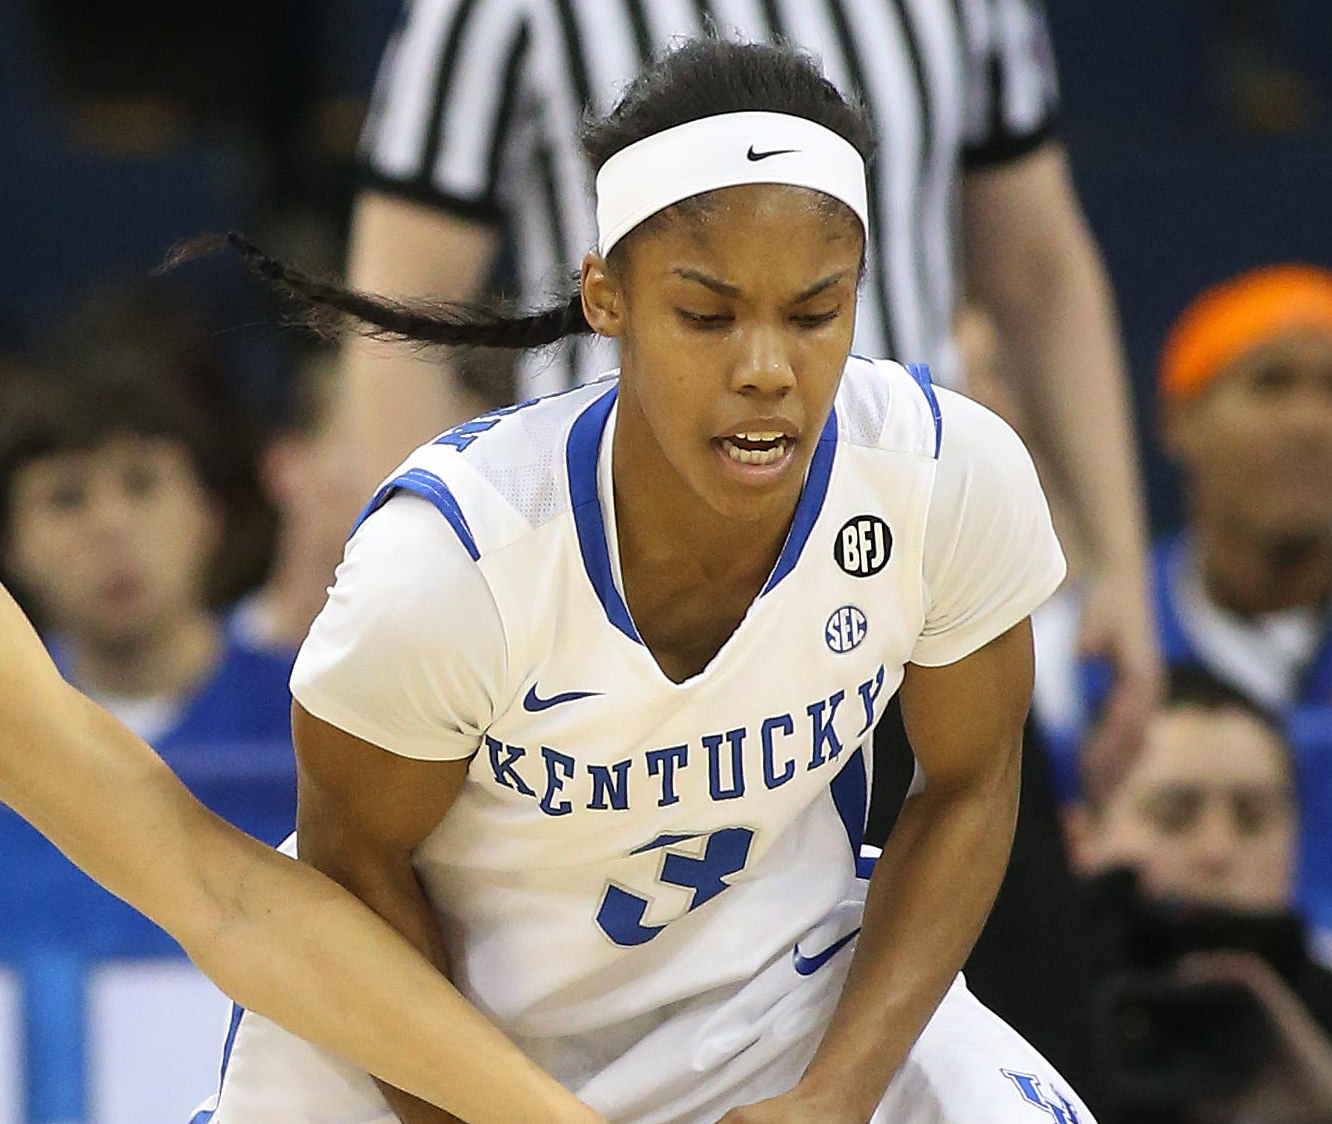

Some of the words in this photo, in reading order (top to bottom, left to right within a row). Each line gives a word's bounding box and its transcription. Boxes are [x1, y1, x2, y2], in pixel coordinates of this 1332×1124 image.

[841, 519, 886, 574] BFJ
[826, 607, 866, 652] SEC
[484, 664, 885, 817] KENTUCKY
[594, 825, 758, 949] 3
